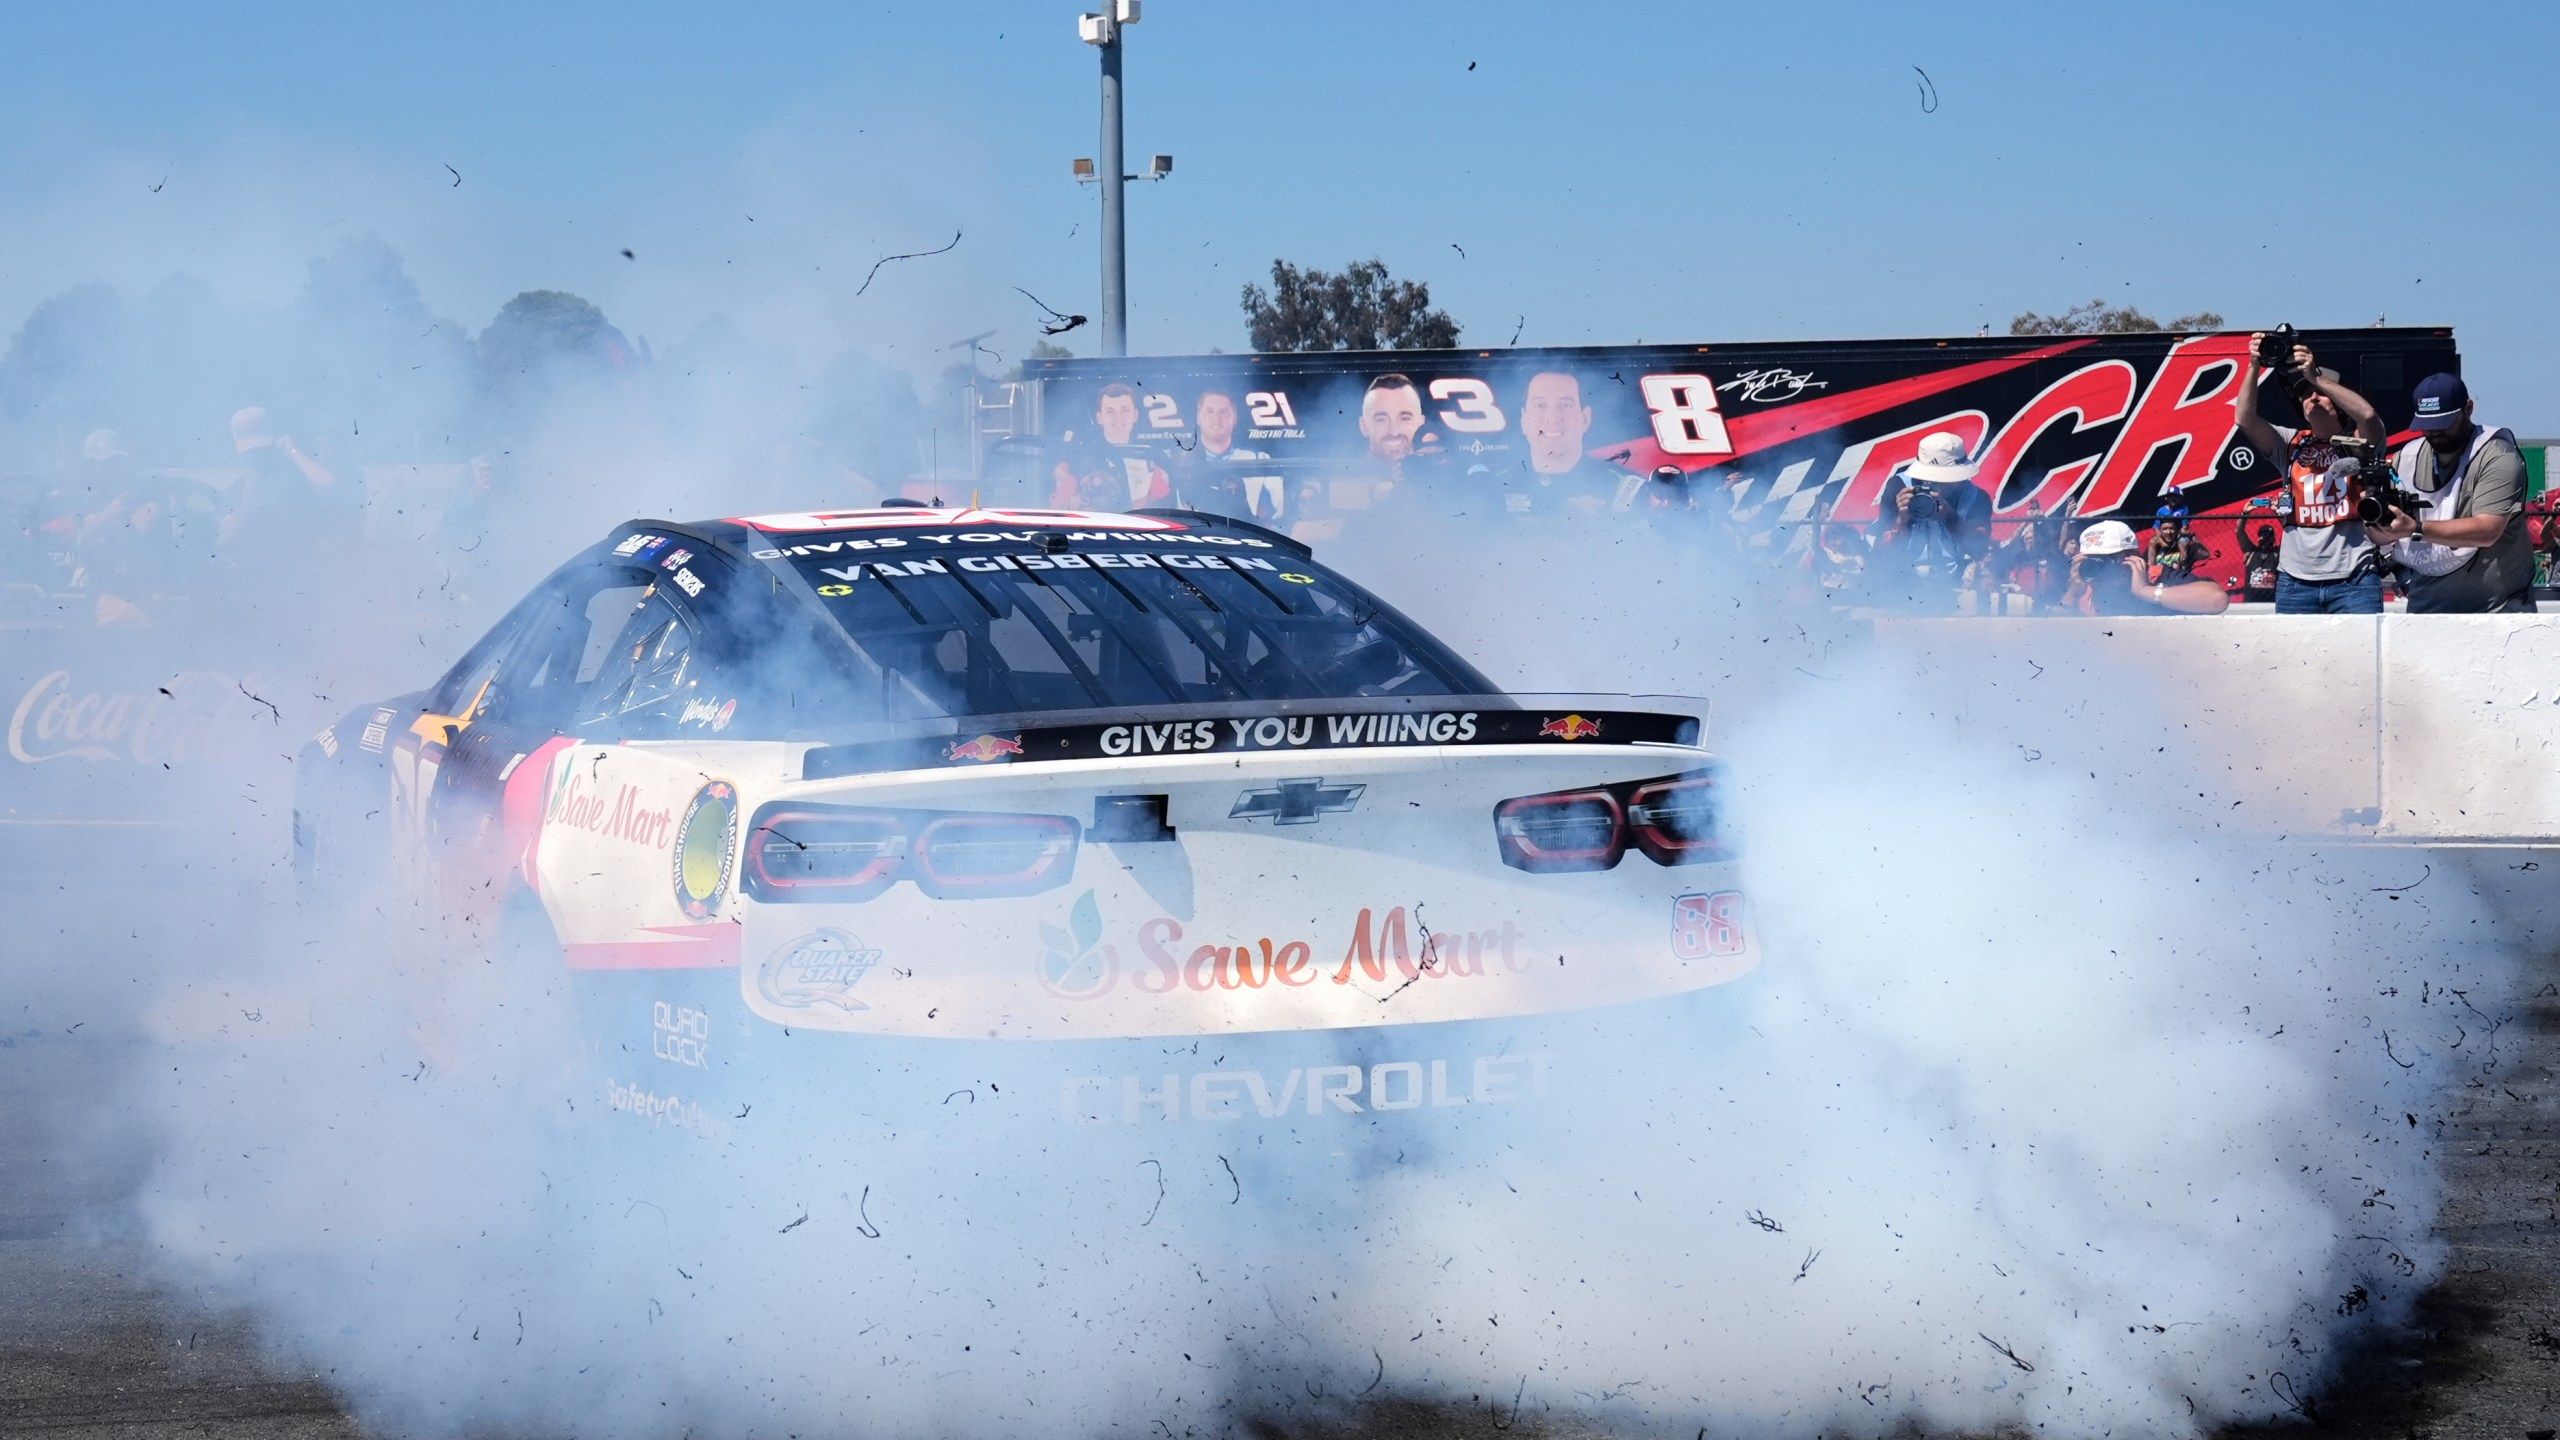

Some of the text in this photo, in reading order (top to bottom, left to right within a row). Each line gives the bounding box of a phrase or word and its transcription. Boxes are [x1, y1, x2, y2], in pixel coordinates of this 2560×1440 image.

[1143, 394, 1184, 427] 2
[1245, 392, 1297, 426] 21
[1429, 378, 1506, 432] 3
[1640, 374, 1734, 454] 8
[750, 537, 907, 560] GIVES
[820, 552, 1278, 582] VAN GISBERGEN
[1099, 712, 1479, 757] GIVES YOU WIIINGS
[559, 774, 671, 850] Save Mart
[1671, 890, 1746, 960] 88
[790, 947, 882, 968] QUAKER
[1131, 904, 1535, 995] Save Mart
[799, 966, 866, 983] STATE
[655, 1001, 708, 1040] QUAD
[654, 1030, 709, 1071] LOCK
